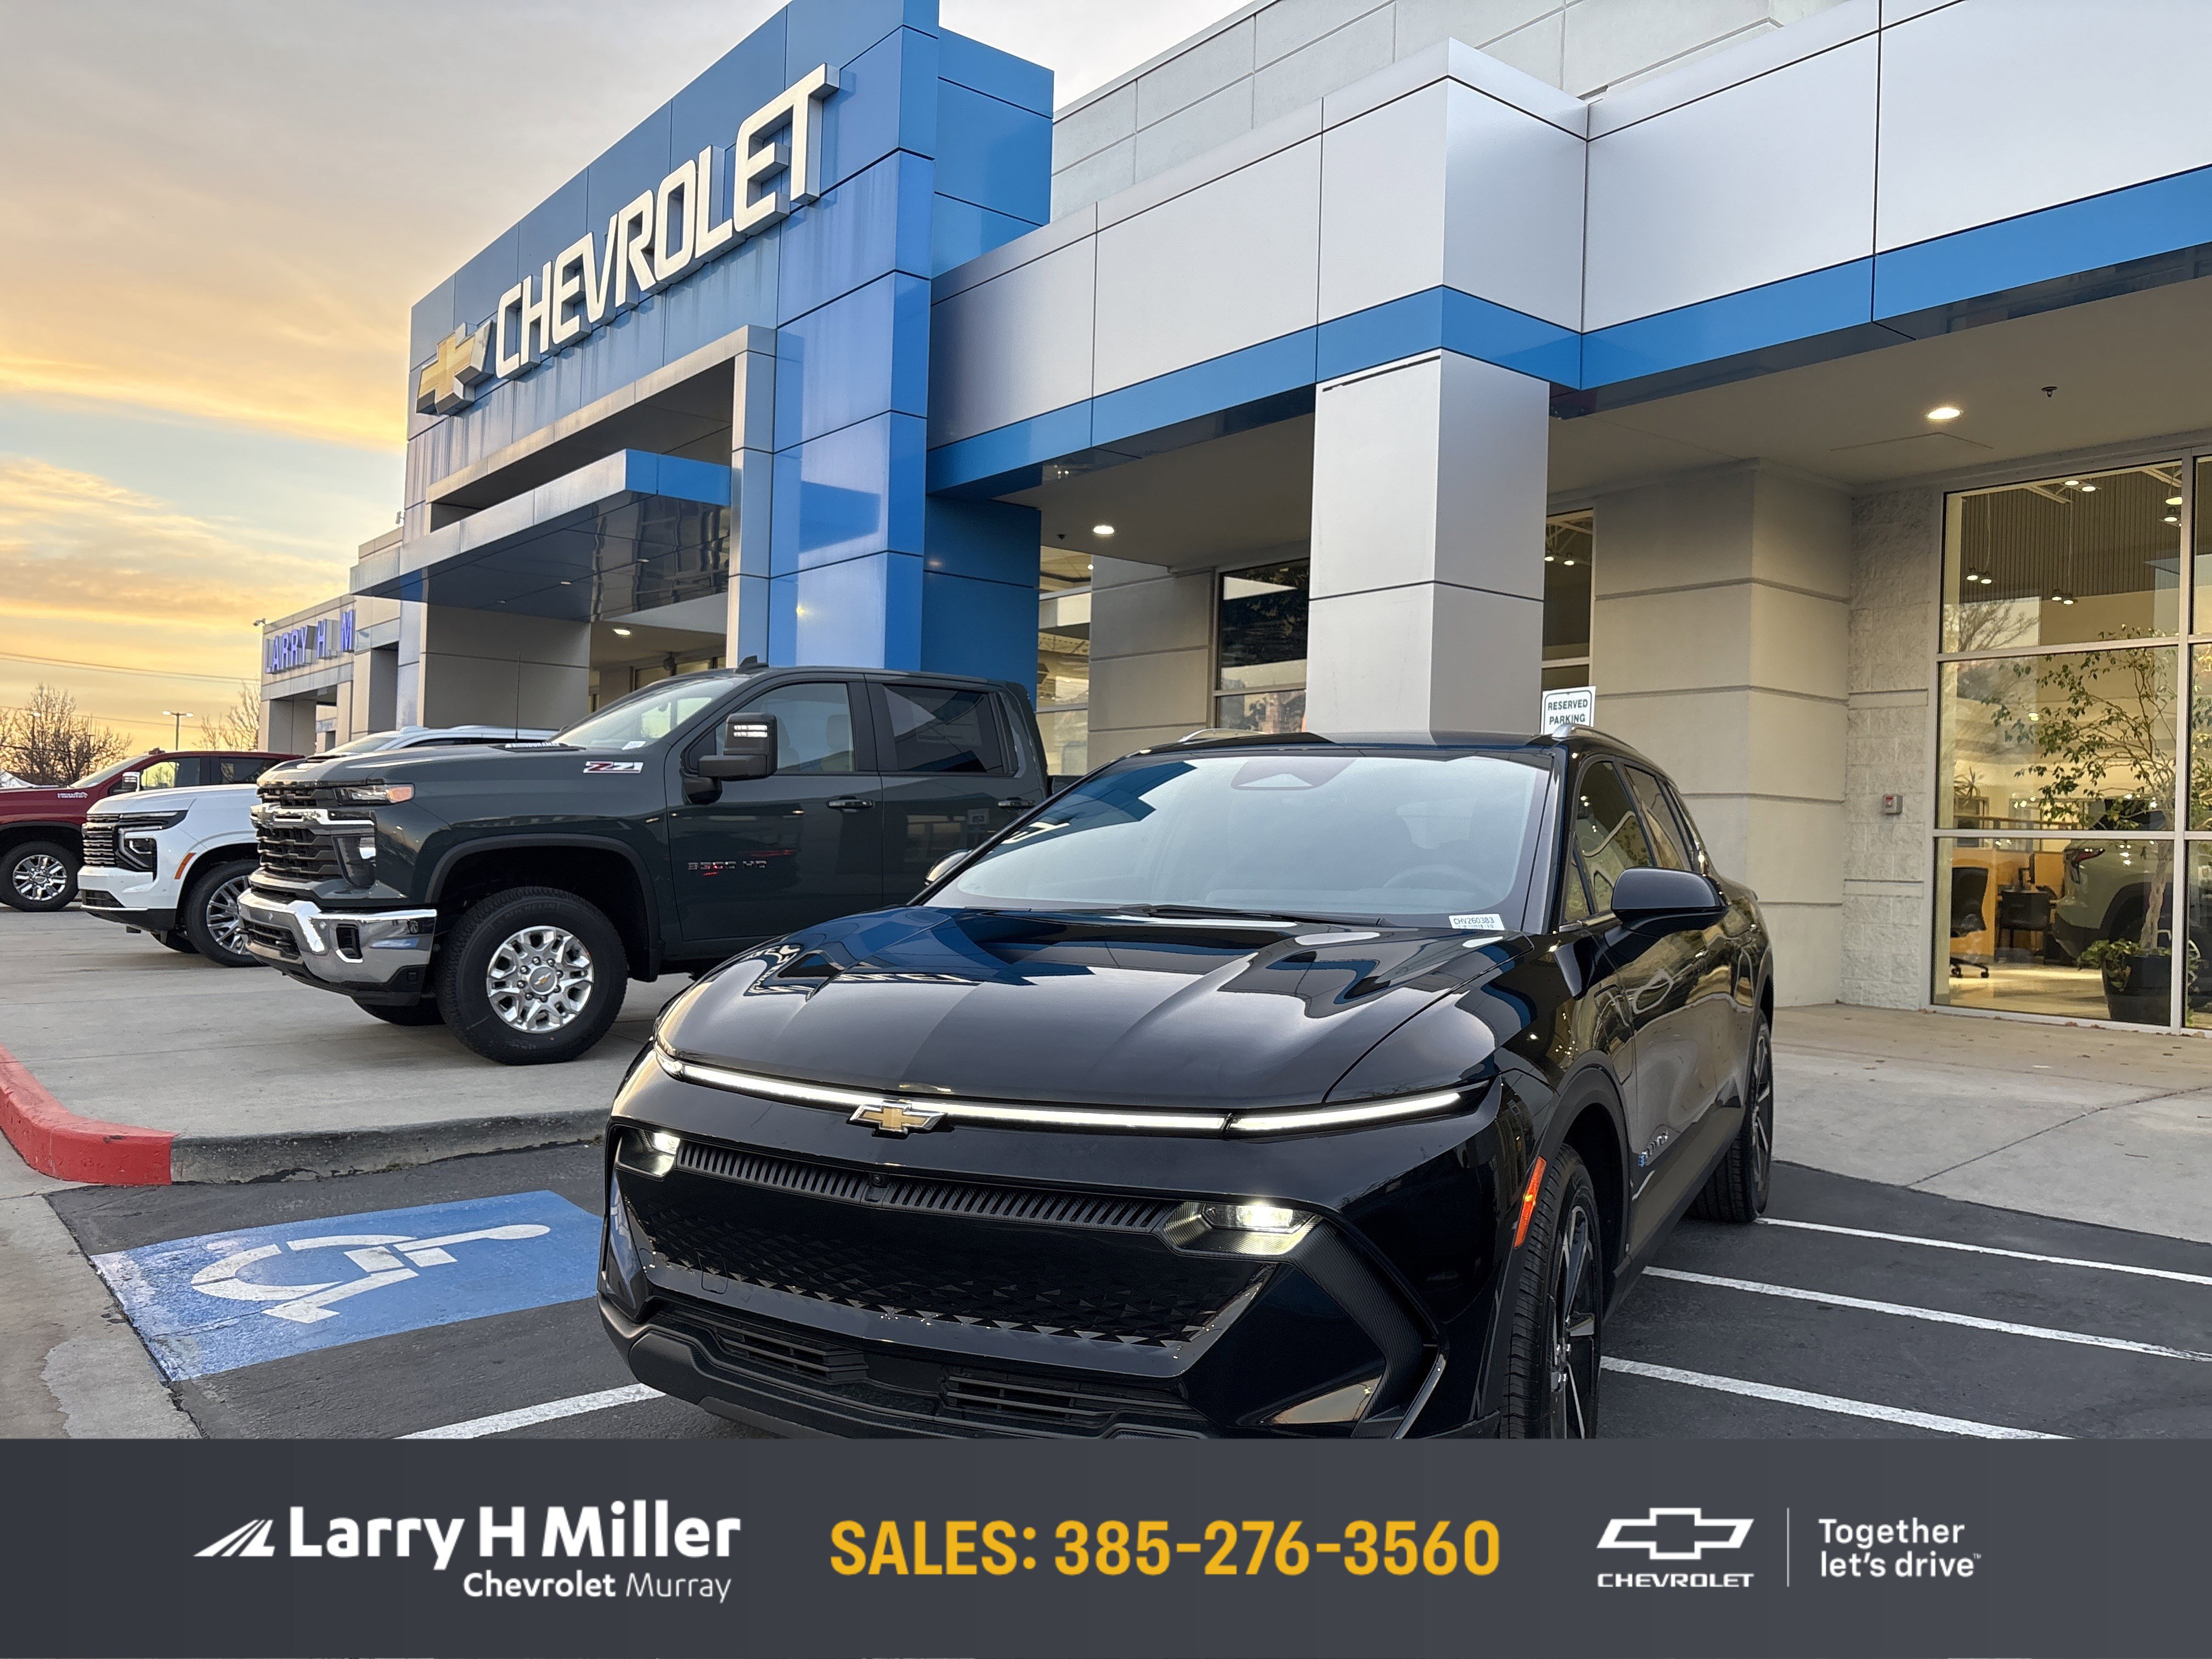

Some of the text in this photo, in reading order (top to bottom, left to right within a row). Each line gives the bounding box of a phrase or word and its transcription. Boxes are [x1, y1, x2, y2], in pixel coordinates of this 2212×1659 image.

[495, 63, 838, 380] CHEVROLET
[265, 625, 308, 674] LARRY
[1548, 699, 1588, 711] RESERVED
[1549, 713, 1585, 725] PARKING
[1453, 917, 1494, 925] CHV260383
